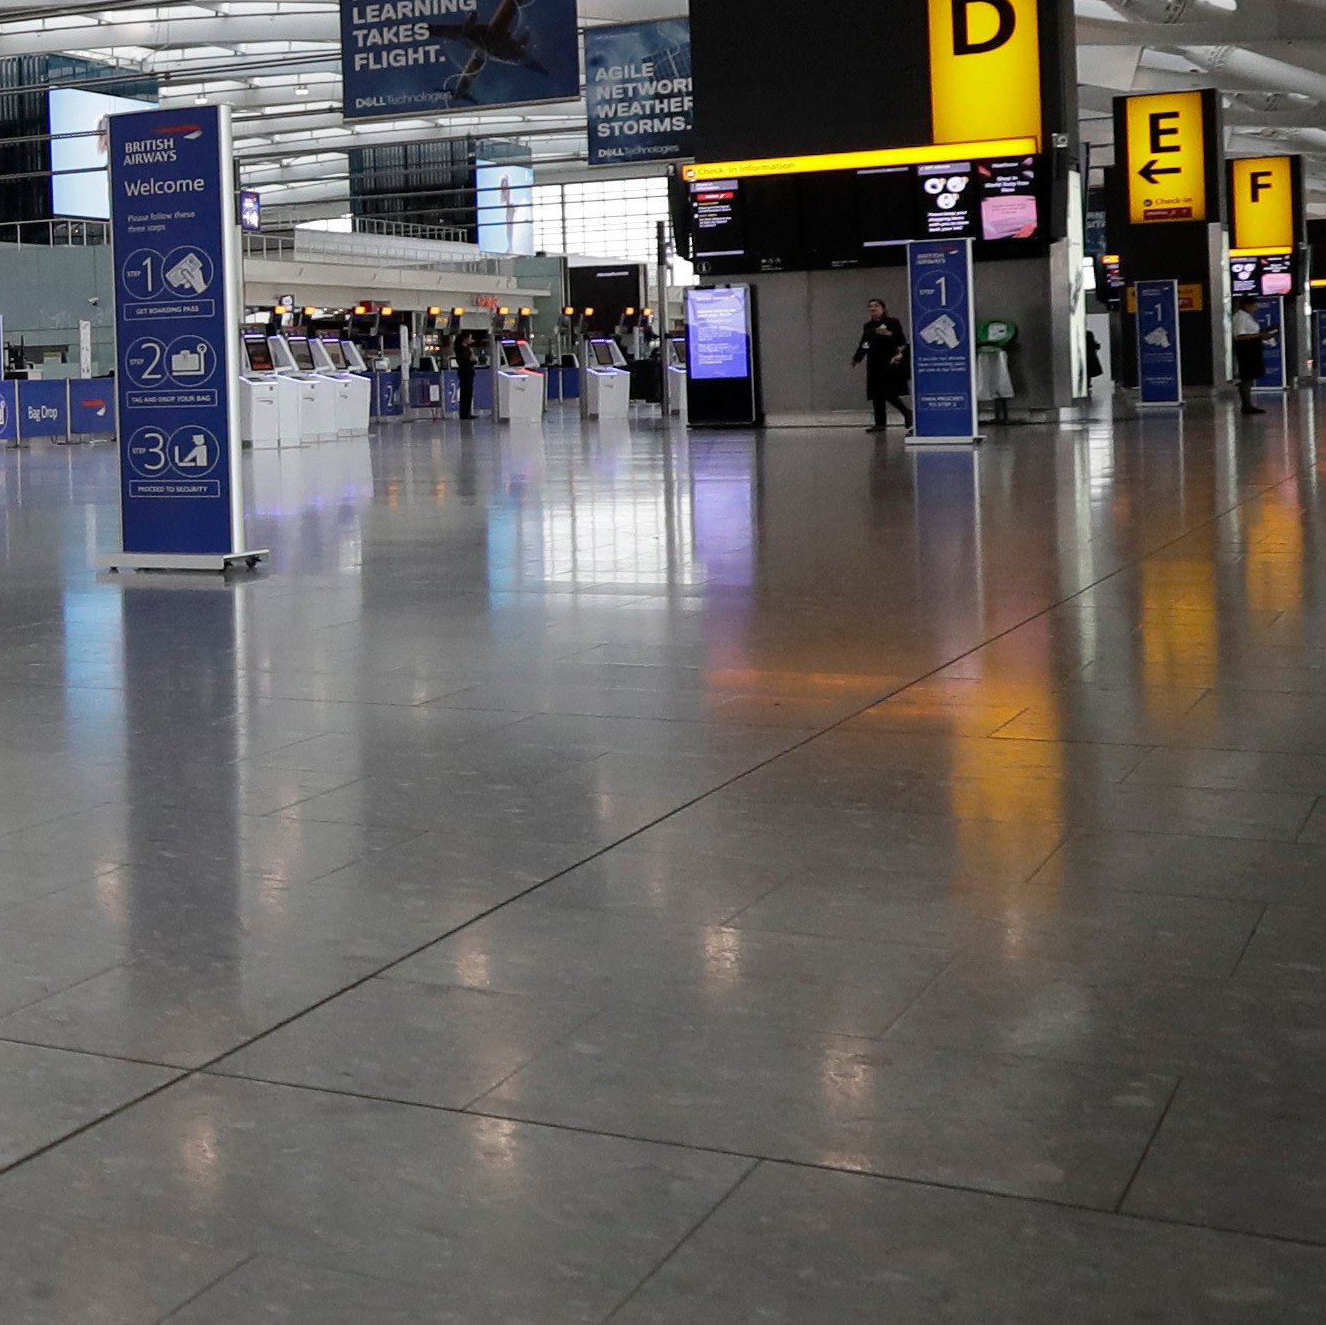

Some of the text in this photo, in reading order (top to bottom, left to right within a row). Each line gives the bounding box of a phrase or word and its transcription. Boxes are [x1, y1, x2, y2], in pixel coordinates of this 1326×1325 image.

[353, 23, 430, 47] TAKES
[354, 45, 446, 71] FLIGHT.
[595, 62, 654, 82] AGILE
[386, 91, 452, 106] Technologies
[597, 116, 692, 137] STORMS.
[1149, 111, 1181, 154] E
[124, 138, 174, 154] BRITISH
[123, 150, 177, 166] AIRWAYS
[124, 177, 205, 196] Welcome
[1250, 171, 1273, 203] F
[127, 211, 196, 222] Please follow these
[147, 223, 166, 232] steps
[142, 256, 152, 292] 1
[935, 276, 946, 306] 1
[149, 306, 182, 314] BOARDING
[140, 342, 162, 379] 2
[196, 394, 211, 402] BAG
[28, 406, 58, 422] Bag Drop
[144, 433, 165, 470] 3
[176, 485, 208, 493] SECURITY
